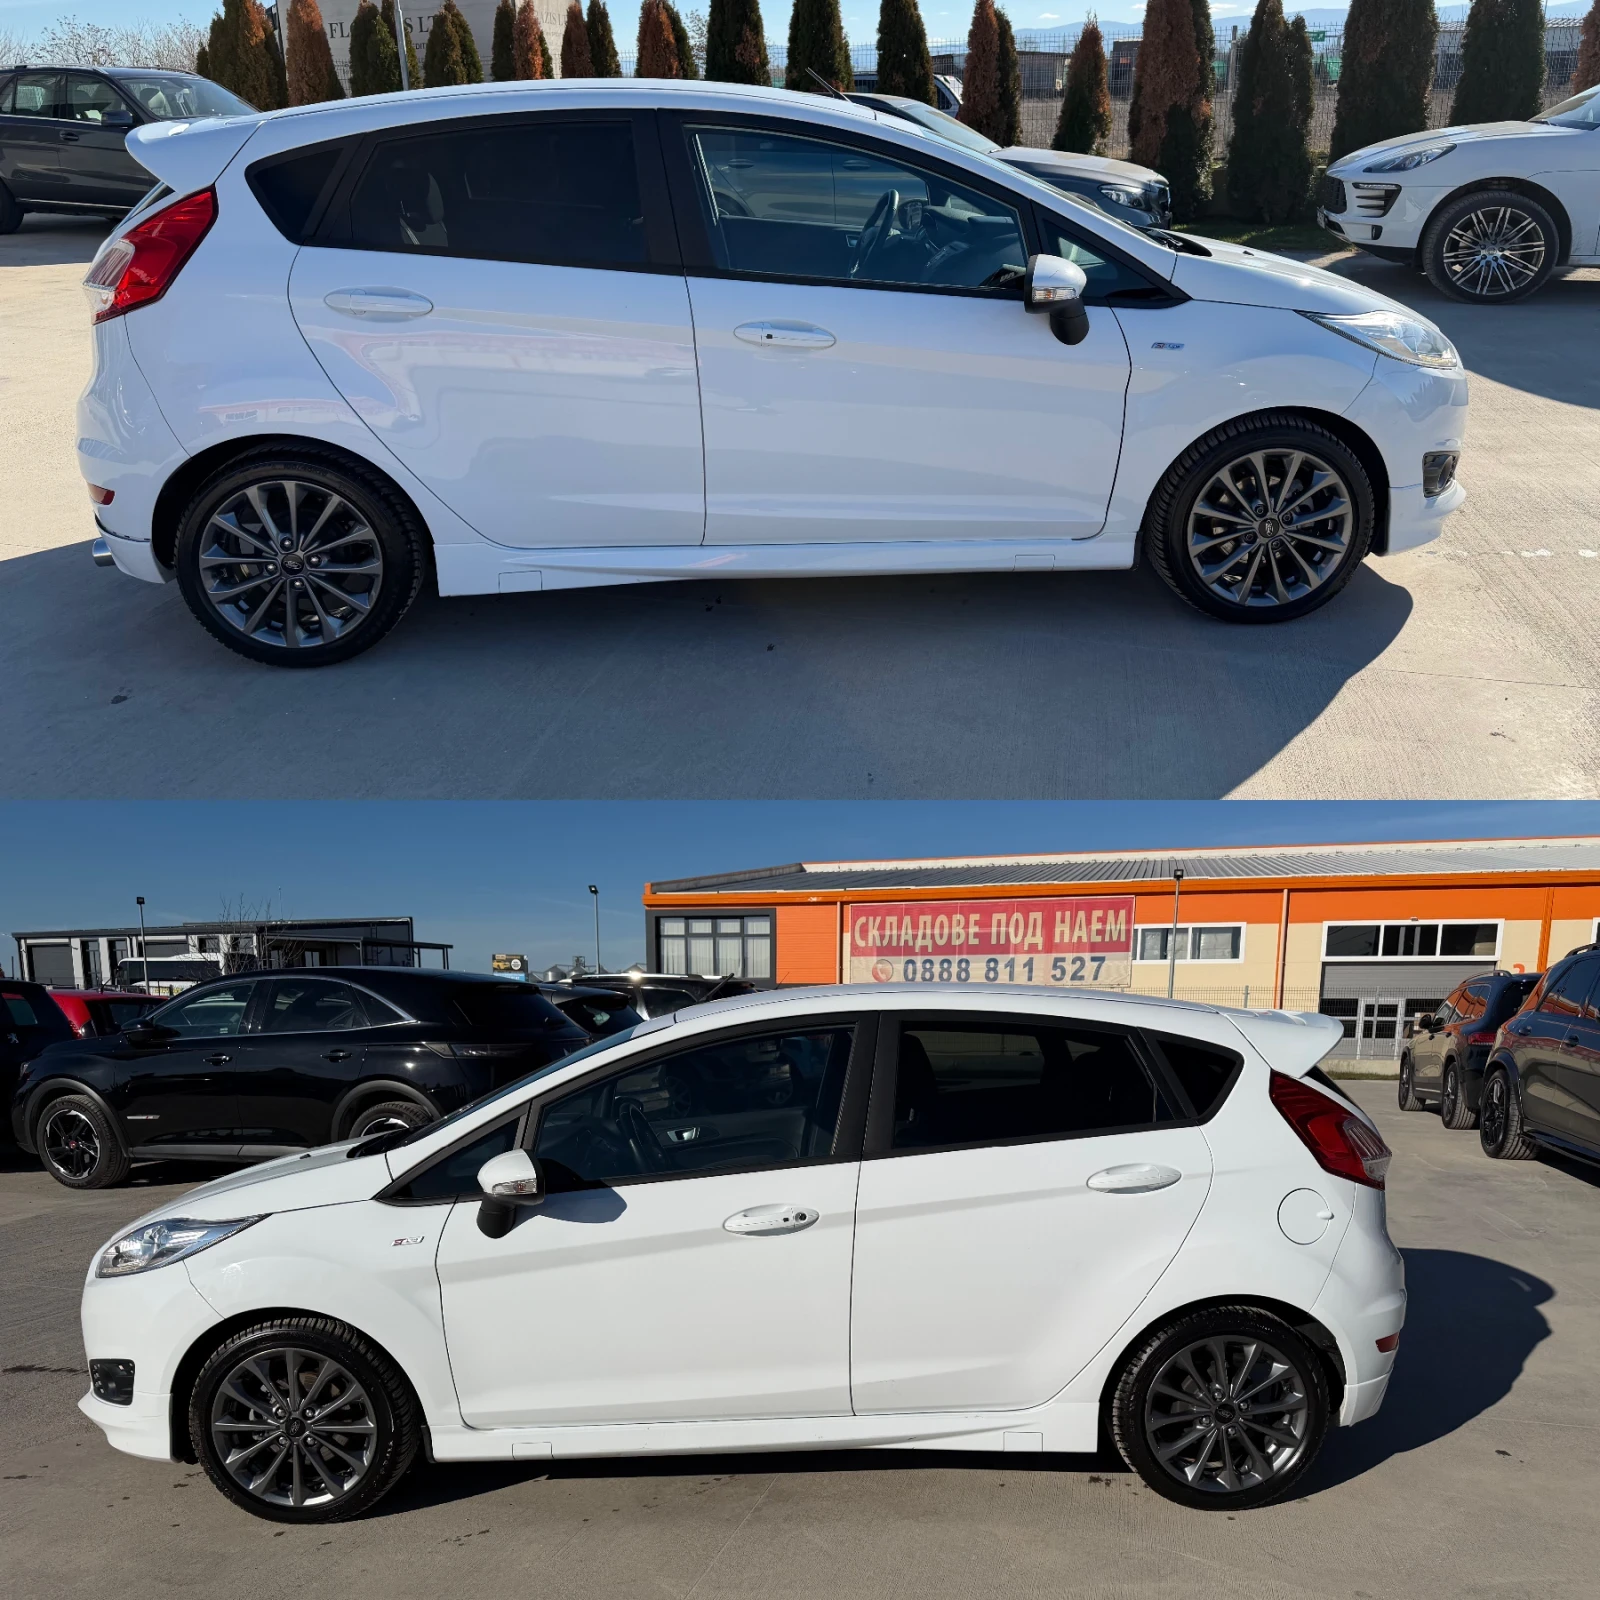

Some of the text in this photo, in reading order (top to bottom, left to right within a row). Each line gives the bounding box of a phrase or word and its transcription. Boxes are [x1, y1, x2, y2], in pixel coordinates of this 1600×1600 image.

[854, 909, 1126, 952] СКЛАДОВЕ ПОД НАЕМ
[903, 956, 1106, 982] 0888 811 527
